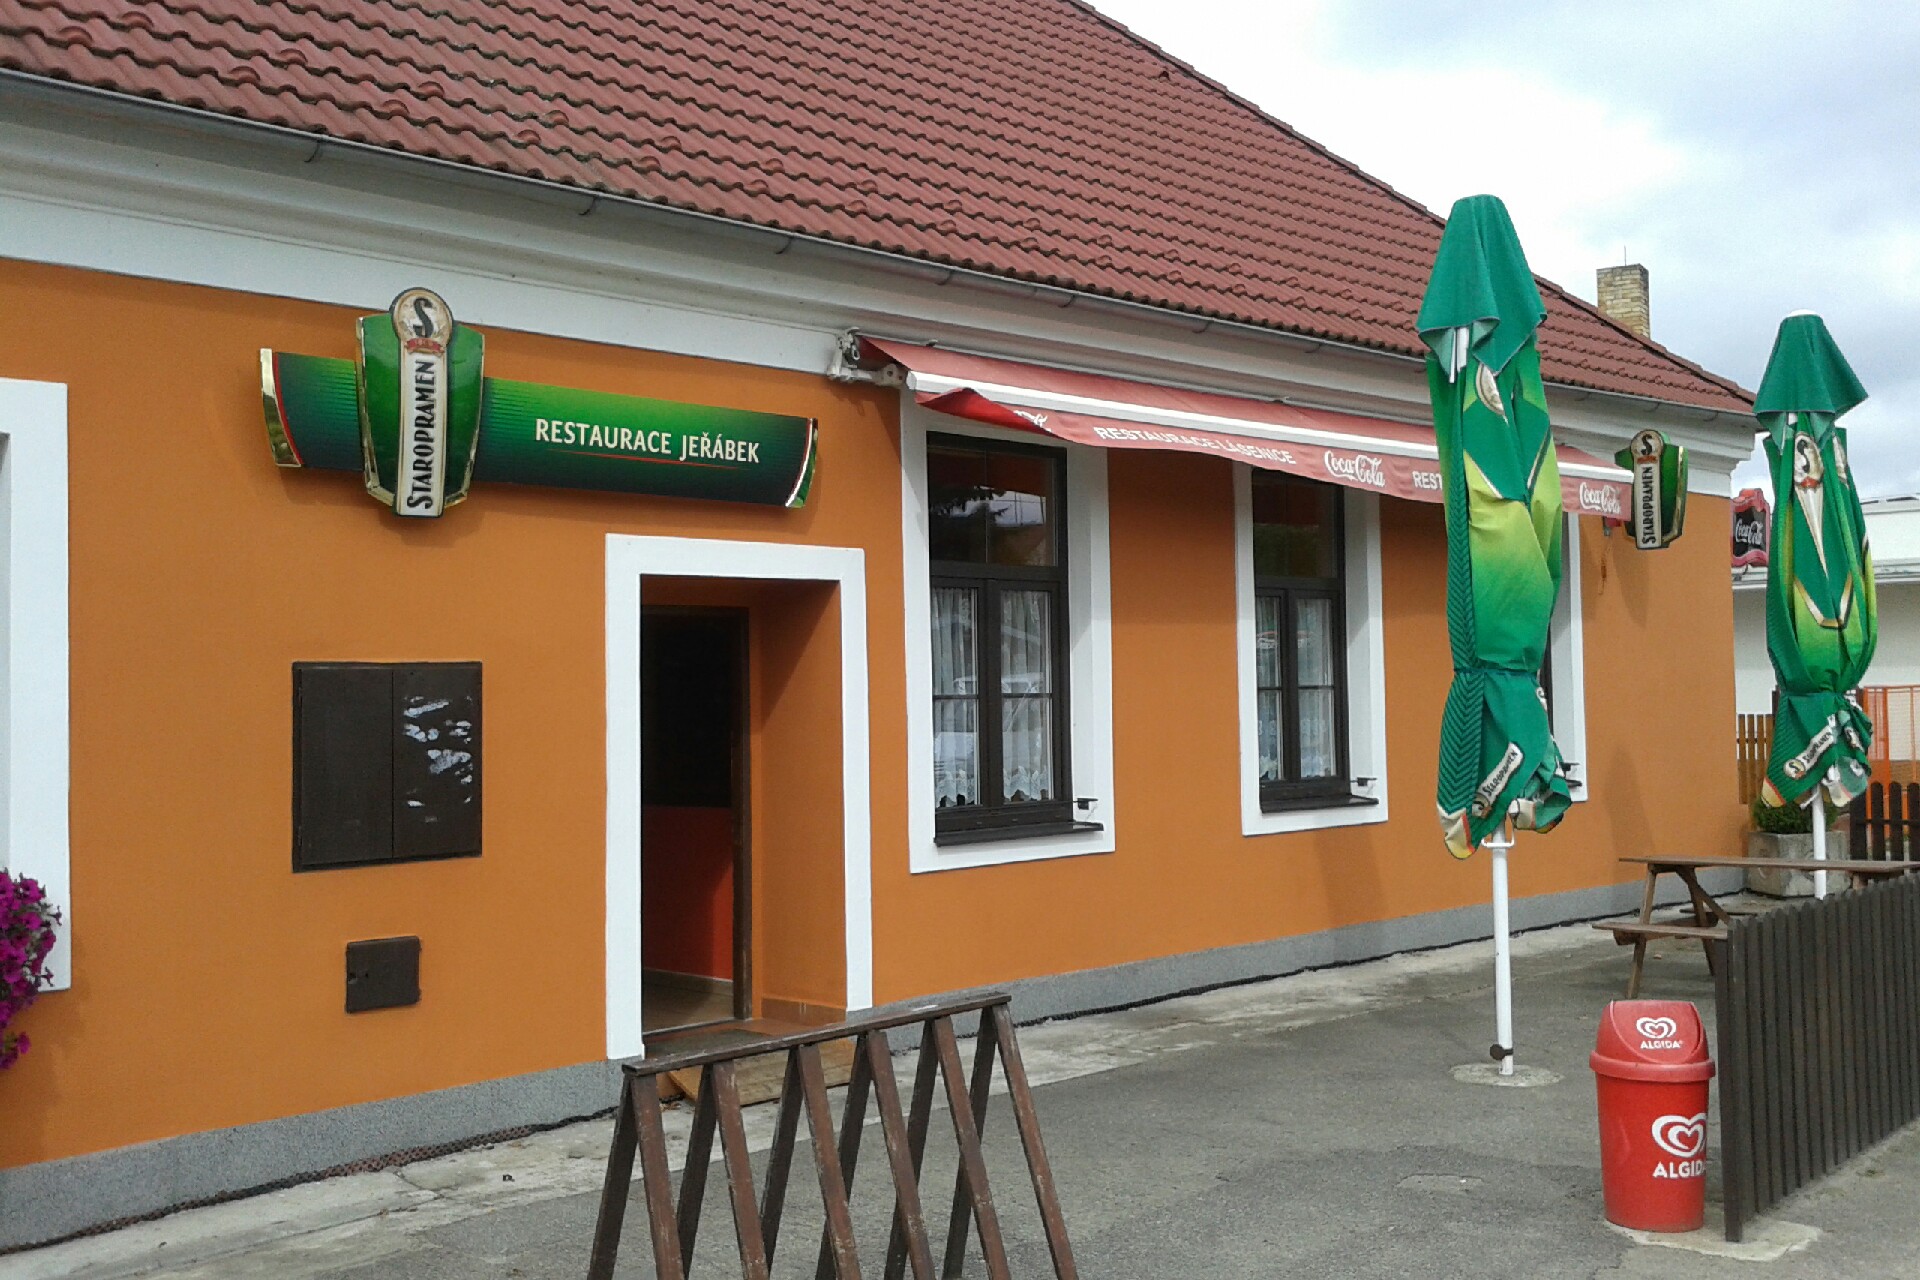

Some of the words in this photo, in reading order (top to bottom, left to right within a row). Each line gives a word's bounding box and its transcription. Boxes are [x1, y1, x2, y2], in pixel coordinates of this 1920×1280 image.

[413, 297, 434, 338] S
[407, 359, 435, 510] STAROPRAMEN
[535, 418, 673, 455] RESTAURACE
[679, 431, 760, 464] JEŘÁBEK
[1093, 426, 1221, 450] RESTAURACE
[1324, 450, 1386, 488] Coca-Cola
[1579, 481, 1621, 514] Coca-Cola
[1642, 466, 1656, 545] STAROPRAMEN
[1640, 1040, 1681, 1049] ALGIDA
